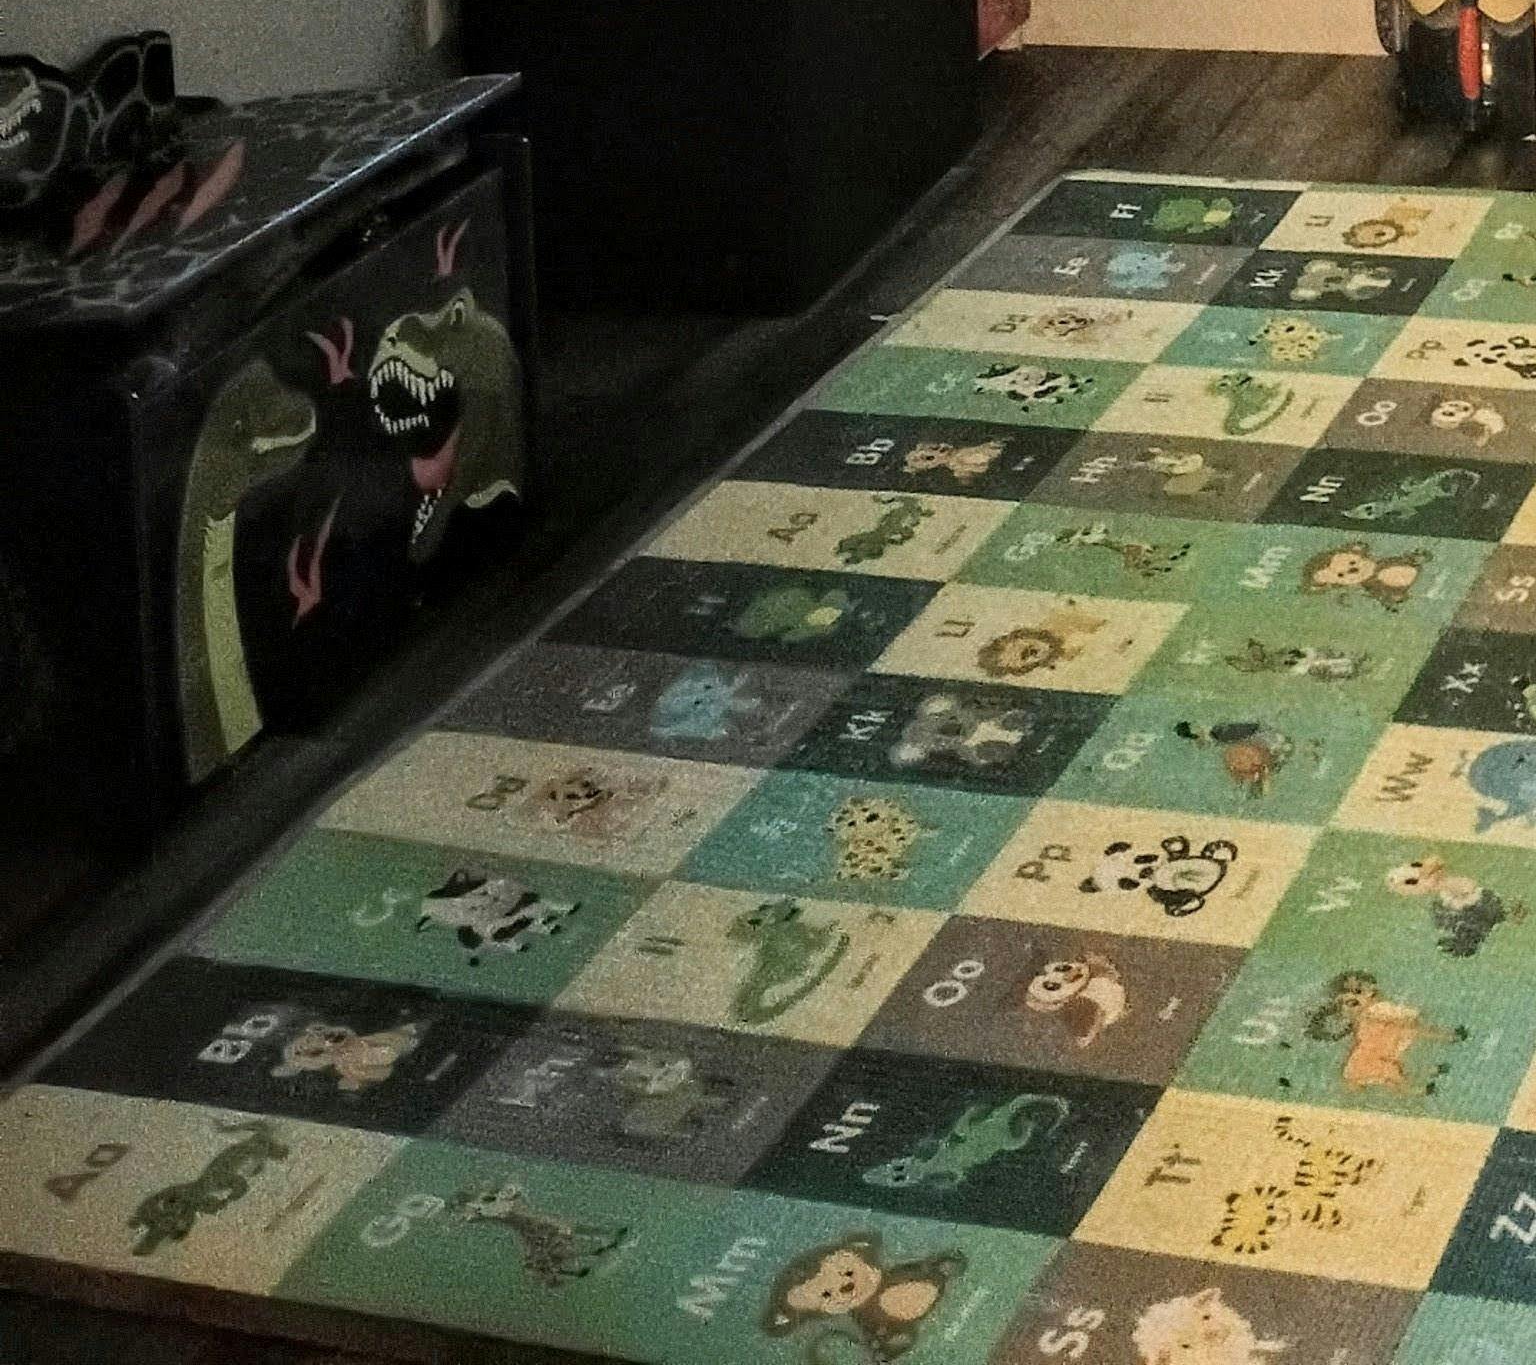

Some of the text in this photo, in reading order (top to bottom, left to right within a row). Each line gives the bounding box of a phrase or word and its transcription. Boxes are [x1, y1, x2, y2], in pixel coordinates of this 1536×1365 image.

[923, 959, 985, 1007] Oo
[198, 1014, 279, 1065] Bb
[807, 1101, 881, 1155] Nn
[1038, 1305, 1106, 1359] Ss
